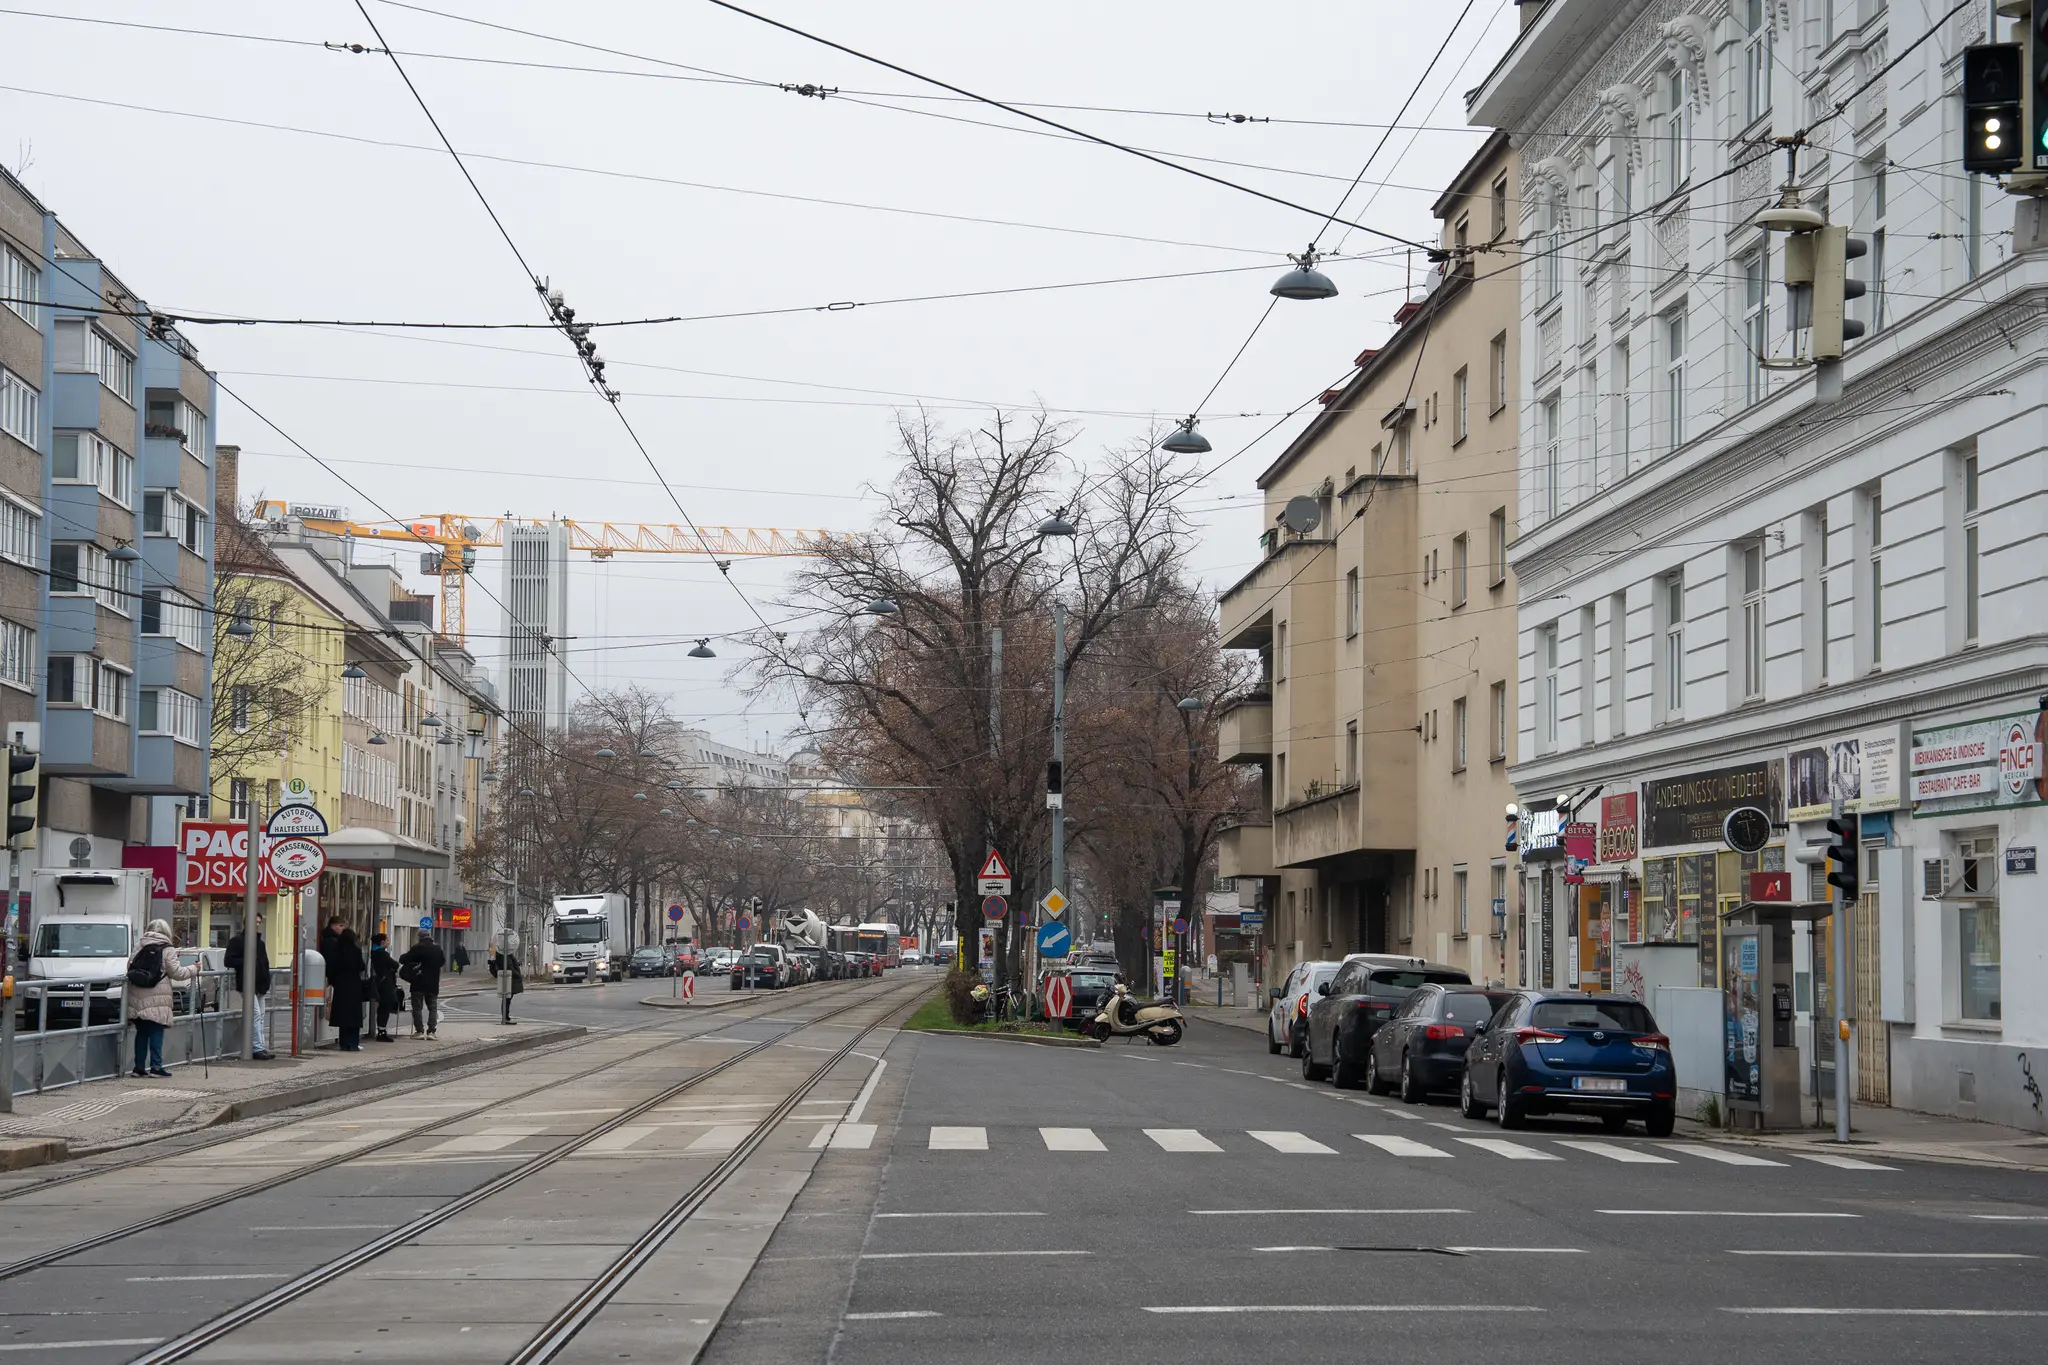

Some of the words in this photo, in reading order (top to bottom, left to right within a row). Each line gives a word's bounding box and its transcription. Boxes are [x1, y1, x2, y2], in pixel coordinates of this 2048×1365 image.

[295, 506, 337, 519] POTAIN
[1914, 747, 1952, 766] MEXIKANISCHE
[1952, 746, 1958, 760] &
[1958, 742, 1986, 759] INDISCHE
[1999, 744, 2034, 773] FINCA
[2004, 771, 2029, 780] MEXICANA
[1655, 769, 1767, 809] ÄNDERUNGSSCHNEIDEREI
[280, 808, 315, 821] AUTOBUS
[186, 829, 283, 858] PAGR
[274, 842, 321, 859] STRASSENBAHN
[186, 861, 283, 887] DISKN
[276, 864, 319, 878] HALTESTELLE
[1764, 880, 1781, 897] A1
